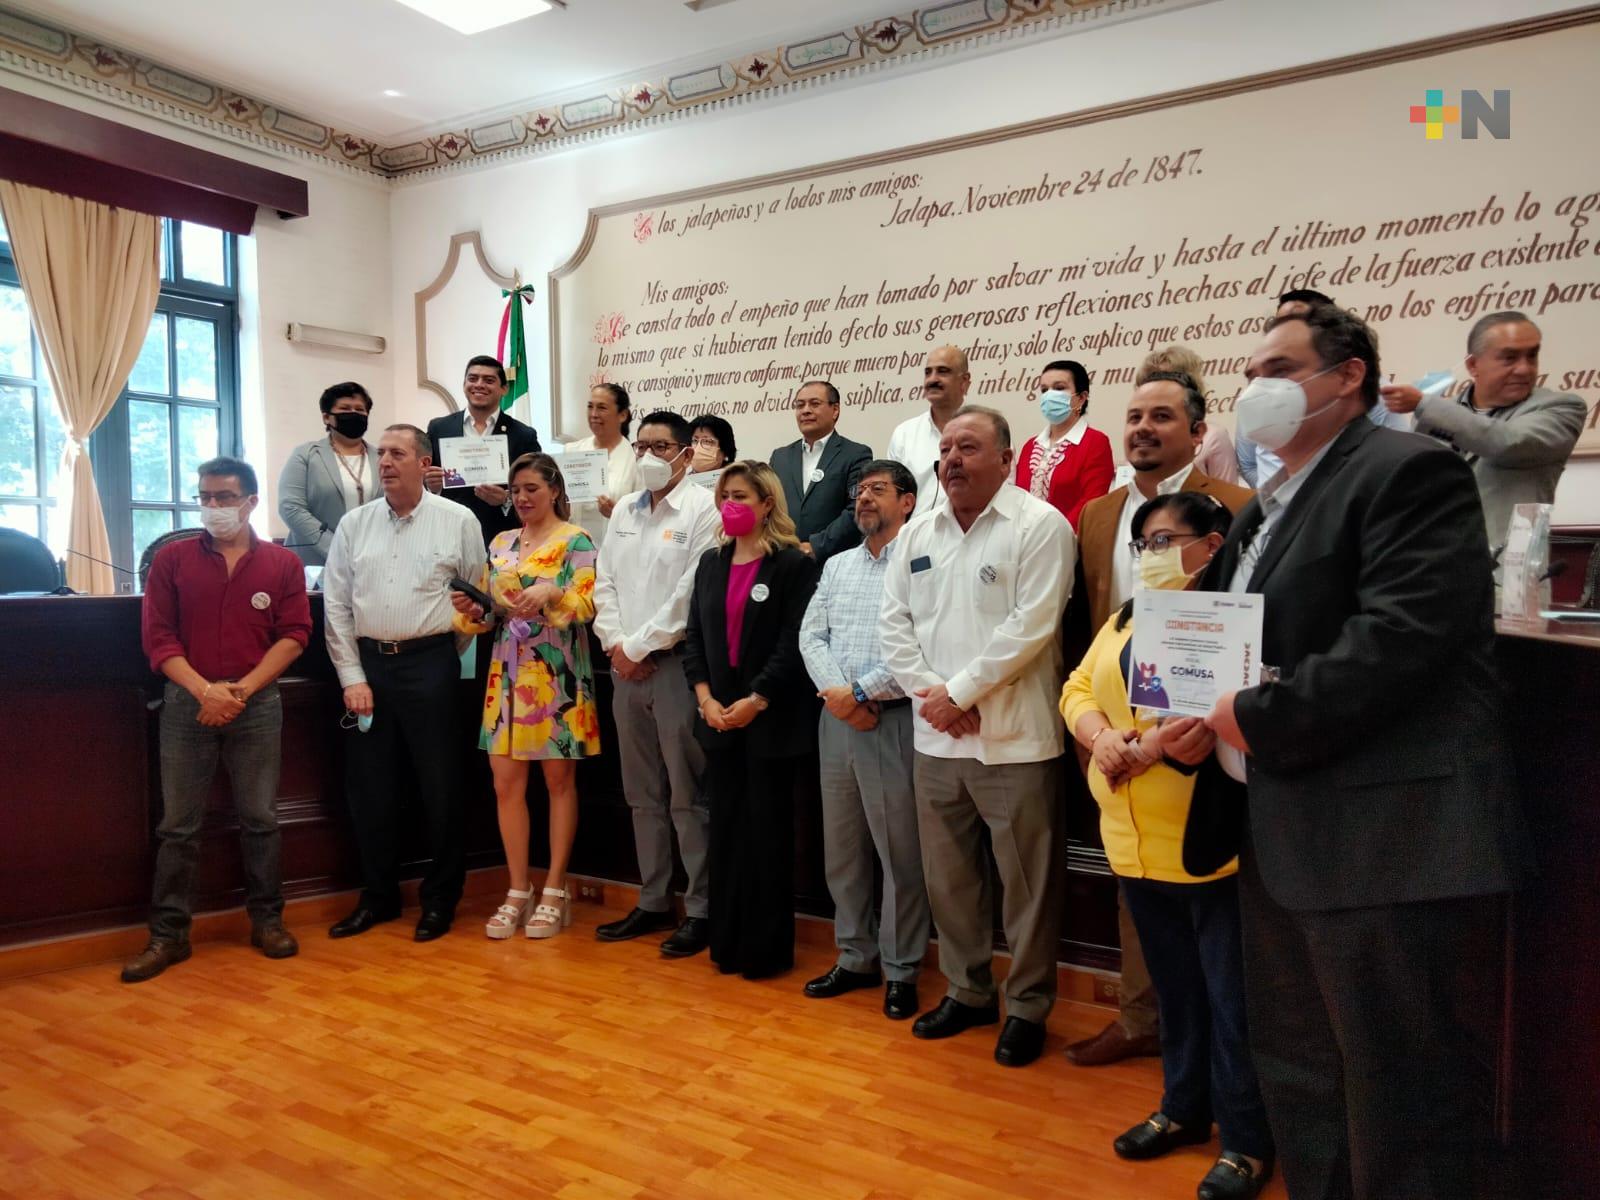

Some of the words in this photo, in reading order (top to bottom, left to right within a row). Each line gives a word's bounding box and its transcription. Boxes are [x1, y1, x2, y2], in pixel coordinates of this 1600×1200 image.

[658, 210, 676, 234] los
[678, 203, 752, 237] jalapeños
[753, 203, 765, 223] y
[768, 199, 780, 214] a
[785, 183, 824, 211] todos
[827, 180, 857, 204] mis
[860, 171, 923, 199] amigos:
[958, 173, 1070, 216] Noviembre
[1073, 168, 1104, 195] 24
[1107, 157, 1139, 190] de
[1143, 148, 1203, 185] 1847.
[635, 307, 682, 335] consta
[684, 304, 715, 329] todo
[720, 299, 738, 323] el
[739, 299, 799, 327] empeño
[803, 297, 831, 321] que
[834, 285, 869, 311] han
[875, 274, 940, 305] tomado
[943, 277, 978, 302] por
[985, 261, 1053, 291] salvar
[1057, 256, 1090, 282] mi
[1091, 244, 1145, 277] vida
[1146, 252, 1166, 279] y
[1173, 233, 1245, 267] hasta
[1251, 225, 1281, 257] el
[1375, 195, 1505, 241] momento
[1514, 190, 1541, 222] lo
[640, 280, 668, 306] Mis
[672, 279, 729, 304] amigos:
[597, 346, 610, 367] lo
[611, 345, 655, 367] mismo
[659, 344, 687, 367] que
[692, 336, 706, 358] si
[708, 331, 778, 356] hubieran
[783, 320, 832, 349] tenido
[839, 314, 888, 348] efecto
[892, 317, 923, 337] sus
[925, 303, 1030, 341] generosas
[1035, 289, 1154, 327] reflexiones
[1157, 274, 1242, 307] hechas
[1245, 264, 1278, 297] al
[1269, 261, 1327, 300] jefe
[1329, 255, 1362, 287] de
[1365, 252, 1391, 283] la
[1381, 248, 1476, 289] fuerza
[1480, 228, 1589, 269] existente
[703, 370, 741, 388] muero
[800, 358, 852, 382] porque
[853, 355, 898, 375] muero
[898, 350, 927, 375] por
[998, 342, 1012, 365] y
[1051, 328, 1075, 353] les
[1079, 322, 1143, 355] suplico
[1147, 325, 1178, 351] que
[1183, 313, 1234, 341] estos
[1364, 303, 1393, 322] no
[1399, 289, 1436, 319] los
[1444, 281, 1537, 322] enfríen
[732, 400, 749, 414] no
[1170, 665, 1214, 679] COMUSA
